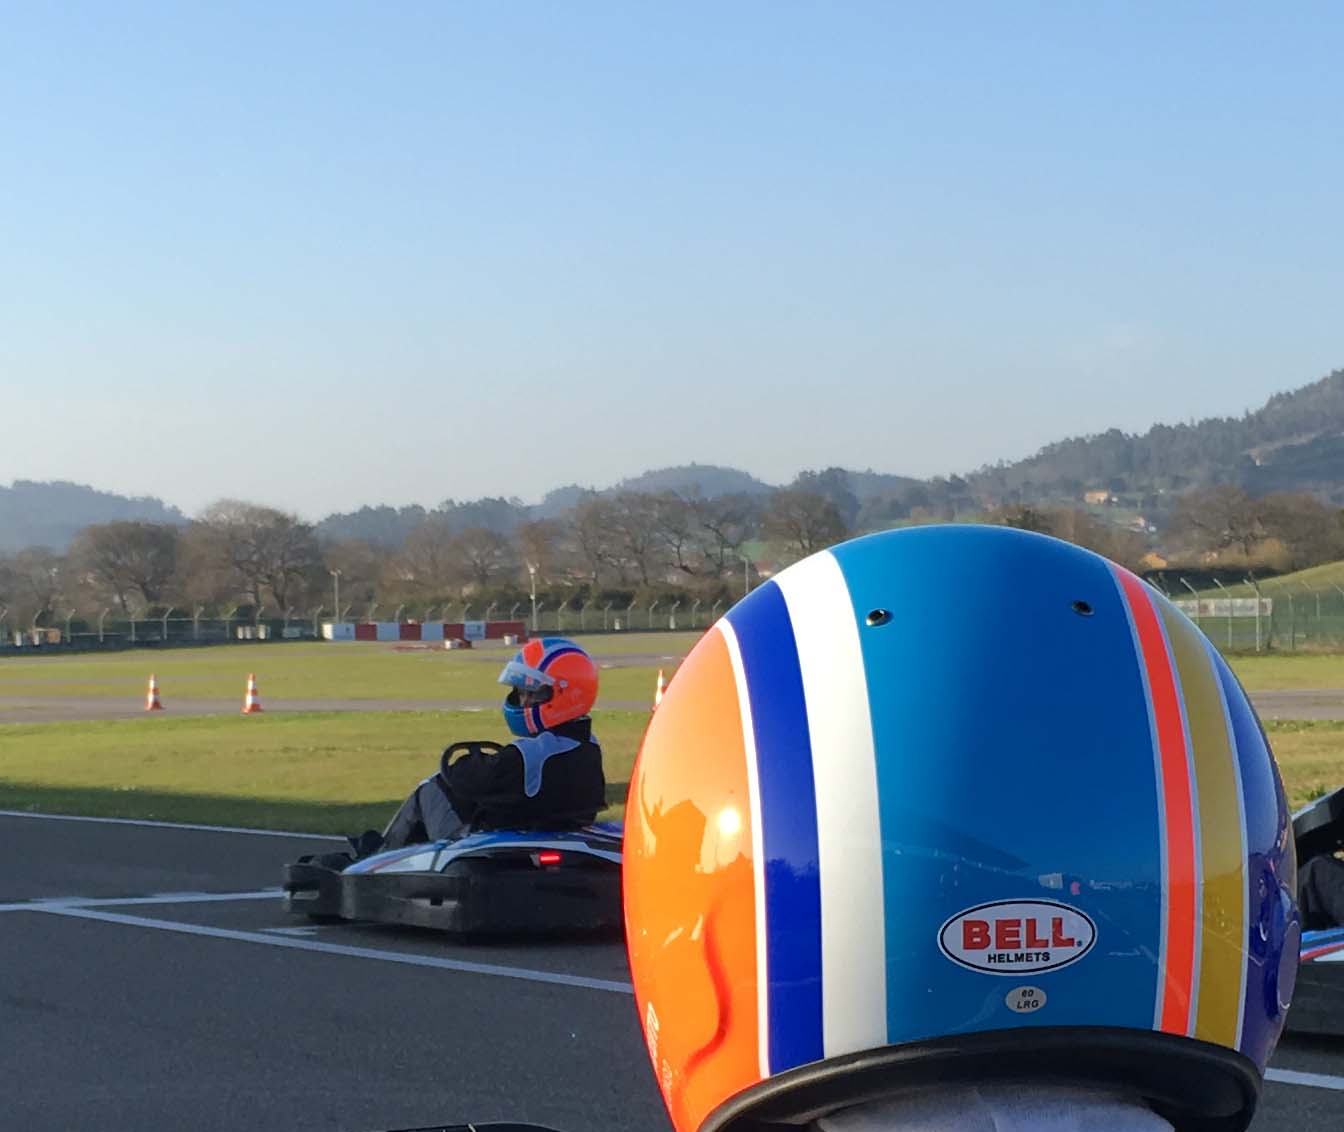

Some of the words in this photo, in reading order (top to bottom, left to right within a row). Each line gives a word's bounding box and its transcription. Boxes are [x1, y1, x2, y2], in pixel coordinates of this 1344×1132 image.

[962, 917, 1076, 951] BELL
[988, 951, 1050, 964] HELMETS
[1016, 999, 1040, 1009] LRG
